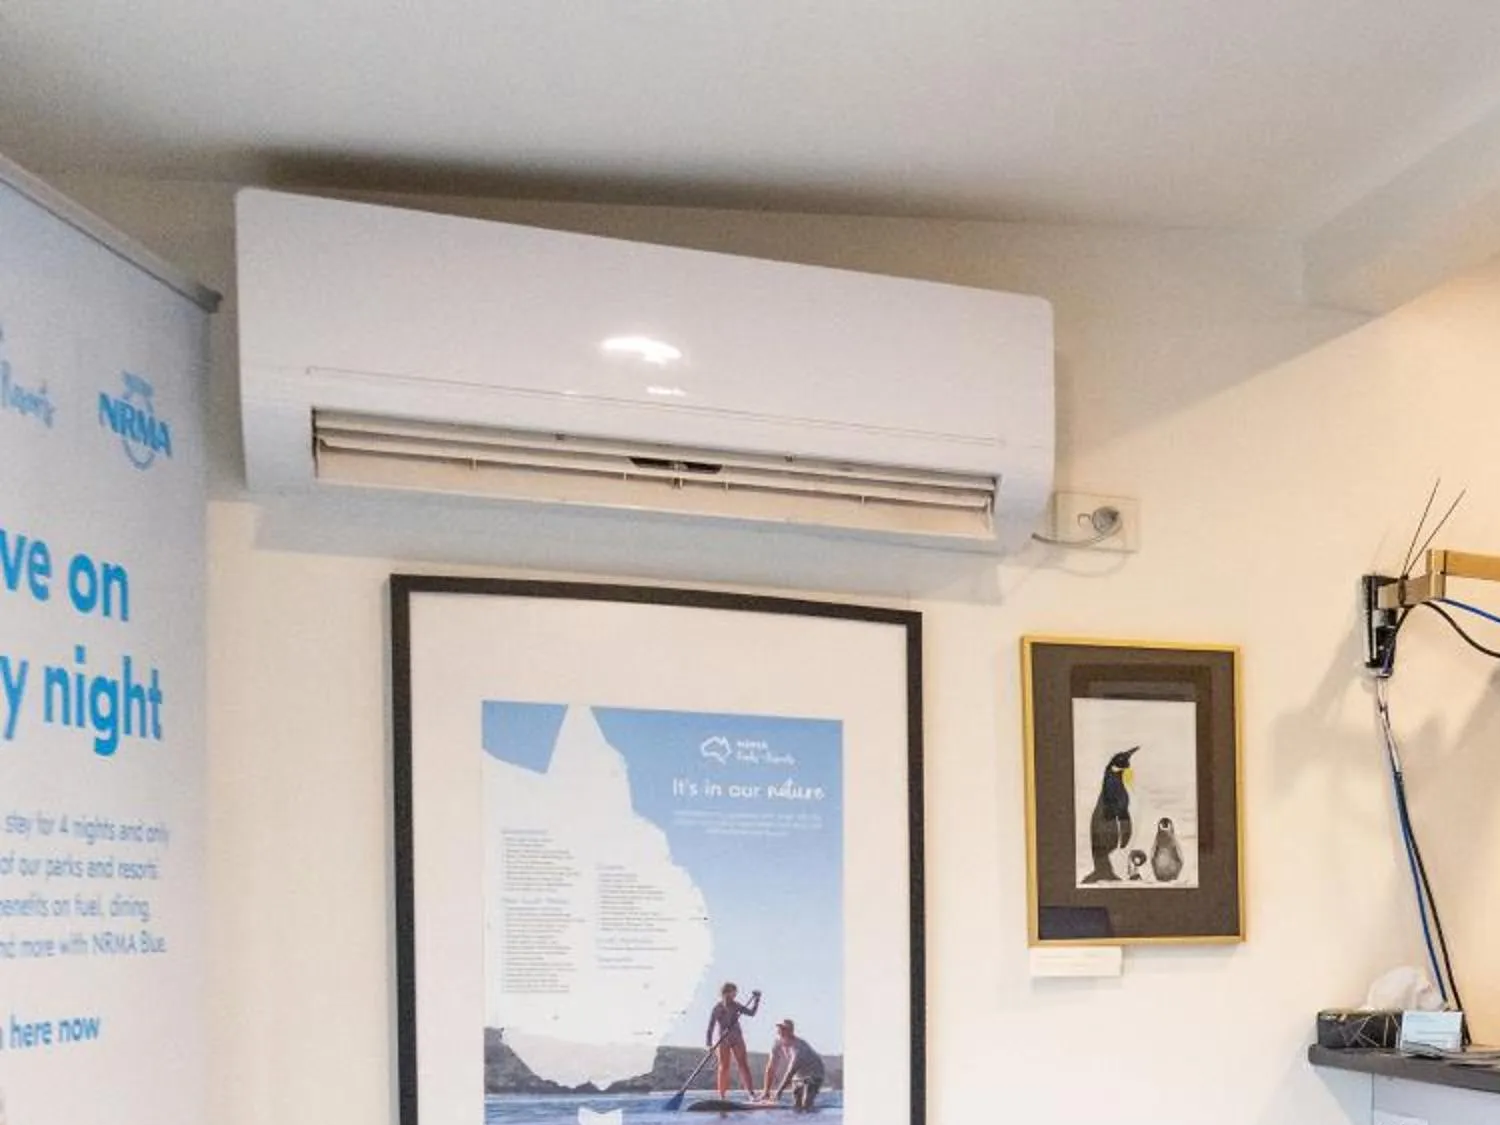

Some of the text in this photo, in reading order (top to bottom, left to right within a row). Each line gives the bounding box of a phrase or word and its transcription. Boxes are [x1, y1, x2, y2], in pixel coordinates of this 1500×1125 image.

[98, 390, 172, 457] NRMA
[68, 553, 129, 622] on
[43, 645, 163, 757] night
[673, 778, 698, 797] It's
[704, 778, 722, 797] in
[728, 784, 760, 798] our
[10, 1015, 53, 1048] here
[58, 1016, 101, 1042] now
